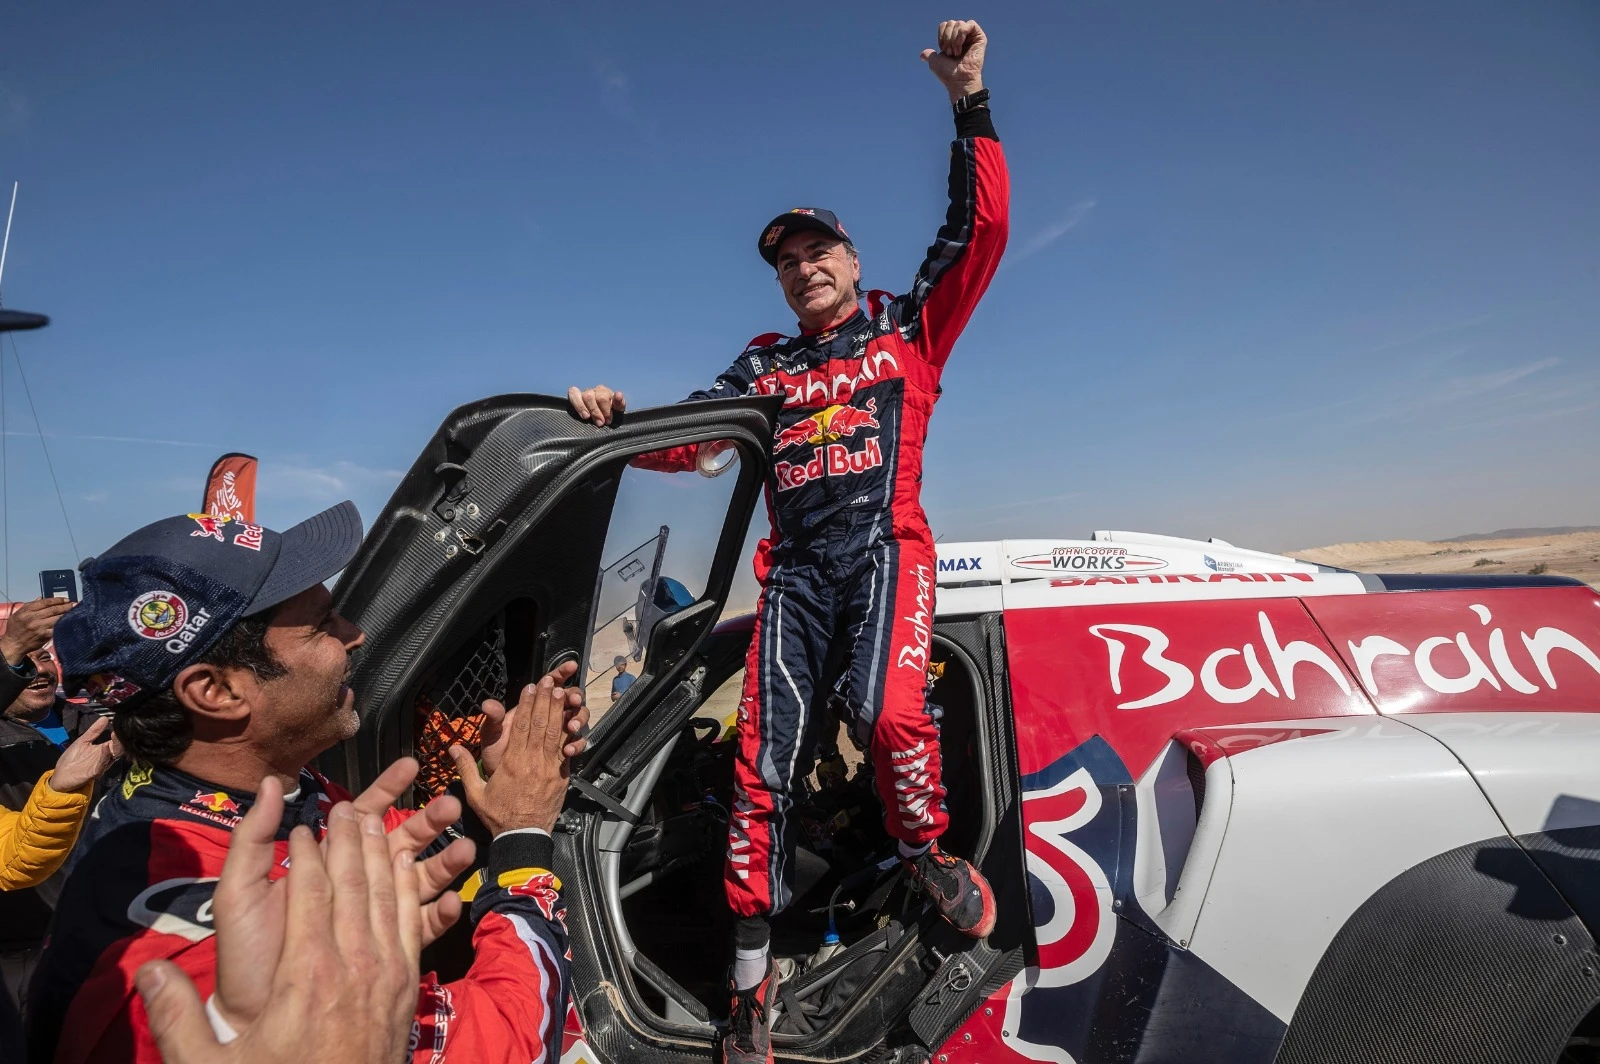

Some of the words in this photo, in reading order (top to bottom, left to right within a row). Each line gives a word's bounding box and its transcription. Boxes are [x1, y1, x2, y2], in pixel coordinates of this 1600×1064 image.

[775, 446, 825, 492] Red
[826, 436, 883, 477] Bull
[1052, 548, 1081, 556] JOHN
[1084, 548, 1126, 556] COOPER
[1052, 556, 1125, 570] WORKS
[165, 607, 212, 654] Qatar
[1089, 604, 1600, 710] Bahrain
[178, 803, 210, 819] Red
